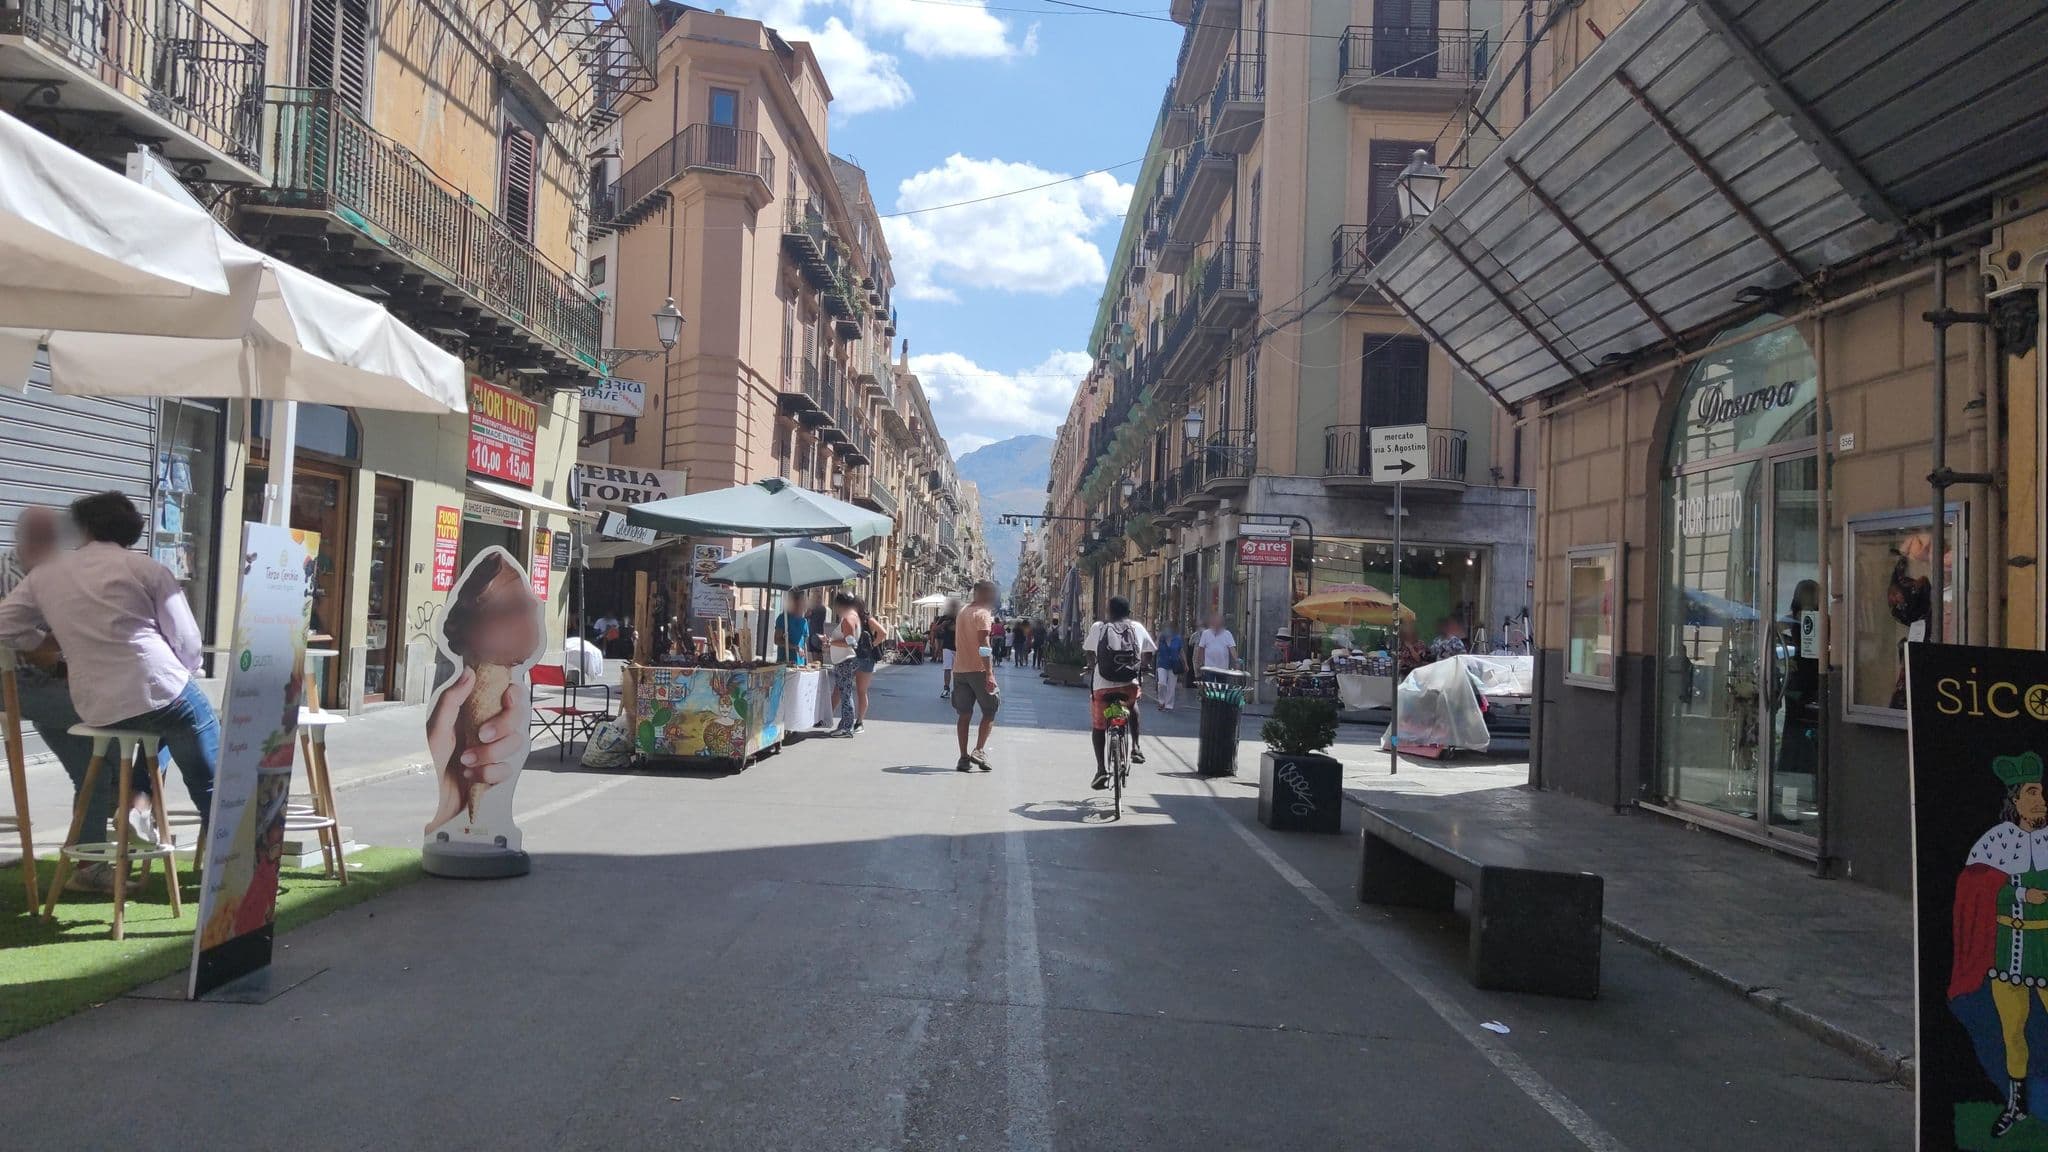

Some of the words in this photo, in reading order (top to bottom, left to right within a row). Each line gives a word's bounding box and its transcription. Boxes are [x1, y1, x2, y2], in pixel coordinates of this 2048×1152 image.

[473, 384, 503, 420] FUORI
[506, 397, 535, 432] TUTTO
[485, 427, 502, 440] MADE
[1384, 432, 1414, 441] mercato
[439, 511, 457, 525] FUORI
[1676, 495, 1706, 537] FUORI
[1707, 490, 1742, 534] TUTTO
[437, 524, 457, 539] TUTTO
[1258, 543, 1287, 552] ares
